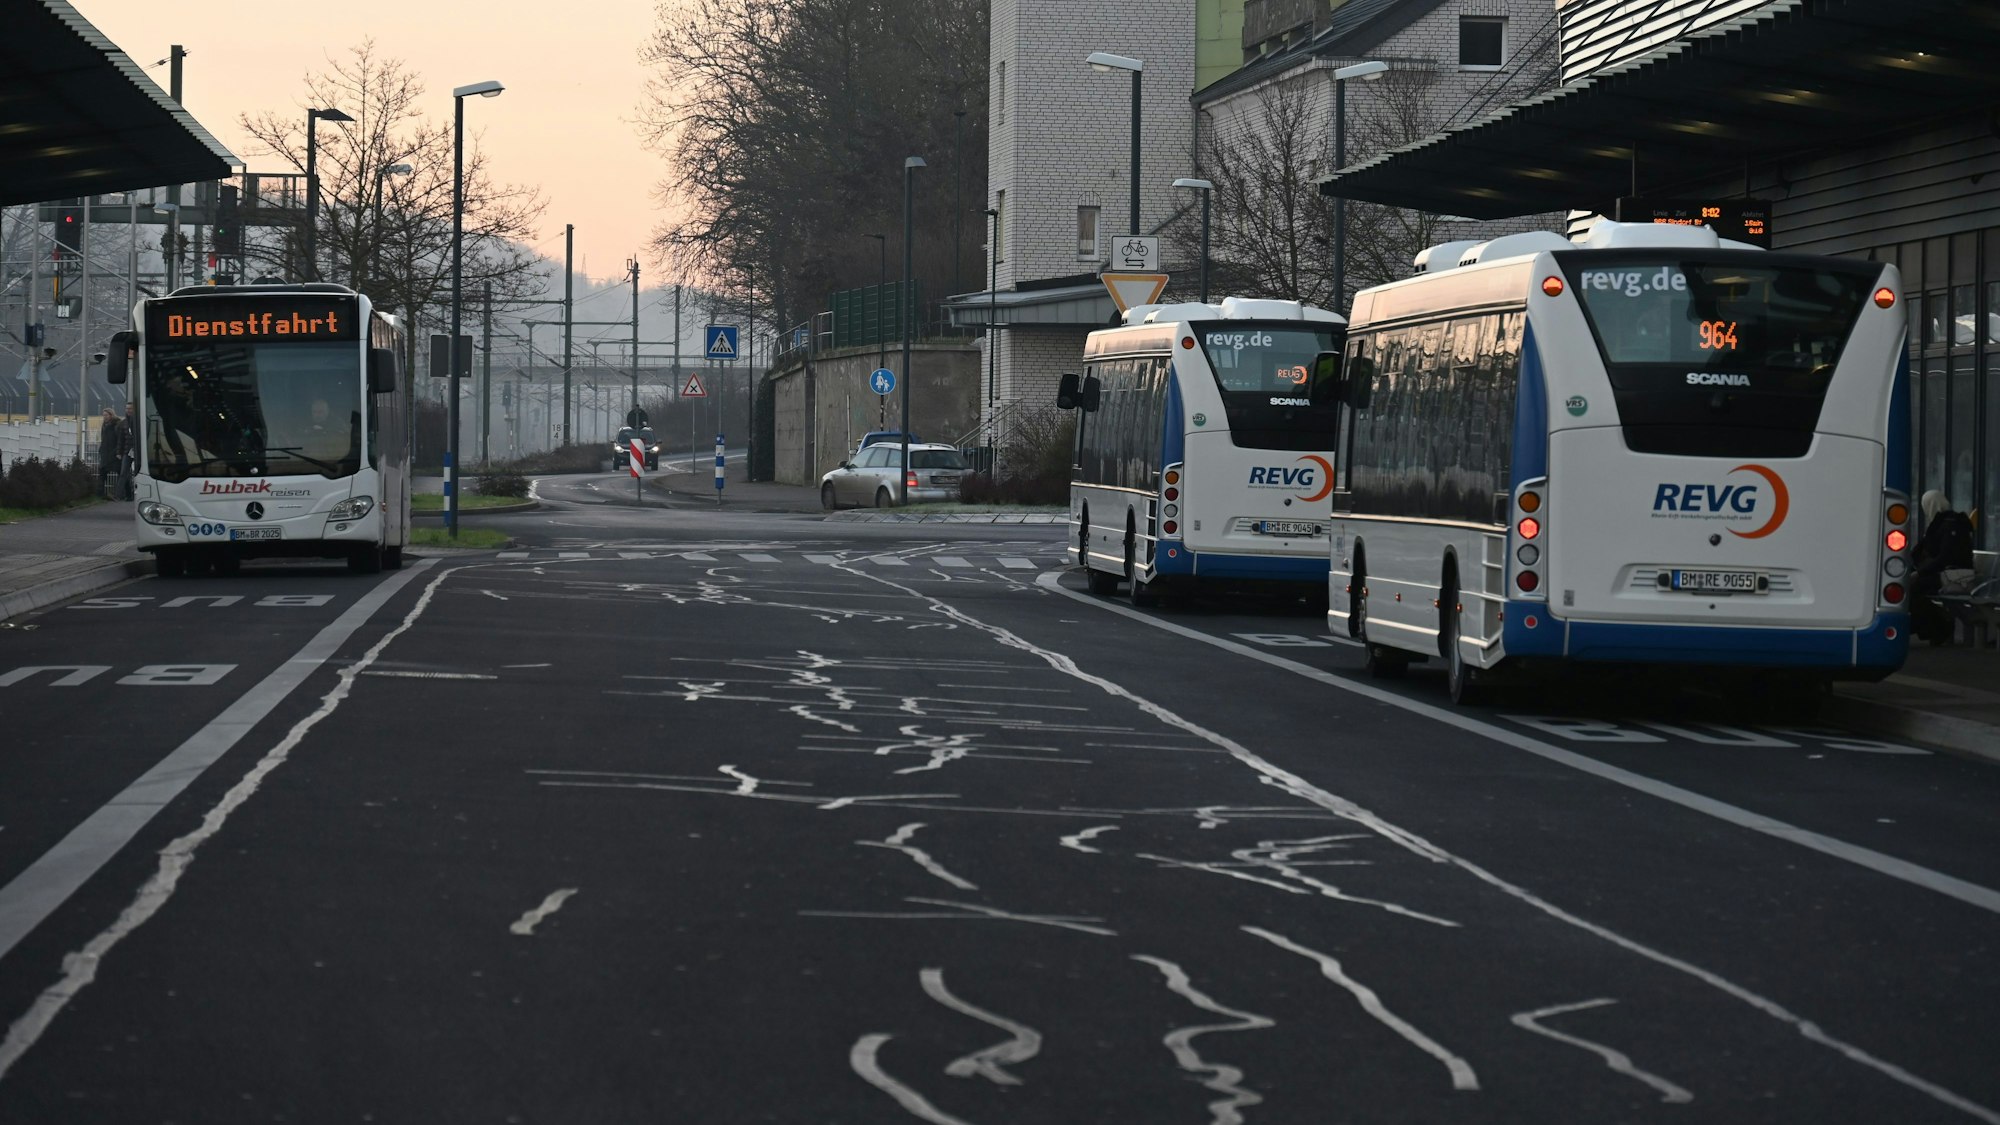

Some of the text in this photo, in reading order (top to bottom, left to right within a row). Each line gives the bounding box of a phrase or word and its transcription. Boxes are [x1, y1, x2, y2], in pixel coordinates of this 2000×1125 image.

[1702, 208, 1720, 218] 8:02
[1580, 266, 1687, 298] revg.de
[168, 311, 338, 337] Dienstfahrt
[1205, 330, 1273, 350] revg.de
[1698, 320, 1738, 351] 964
[1685, 372, 1751, 387] SCANIA
[1269, 397, 1311, 407] SCANIA
[552, 424, 561, 432] 18
[1249, 467, 1314, 486] REVG
[199, 478, 311, 497] bubak reisen
[1653, 483, 1757, 513] REVG
[235, 529, 280, 539] BM BR 2025
[1266, 522, 1312, 533] BM RE 9045
[1681, 573, 1753, 588] BM RE 9055
